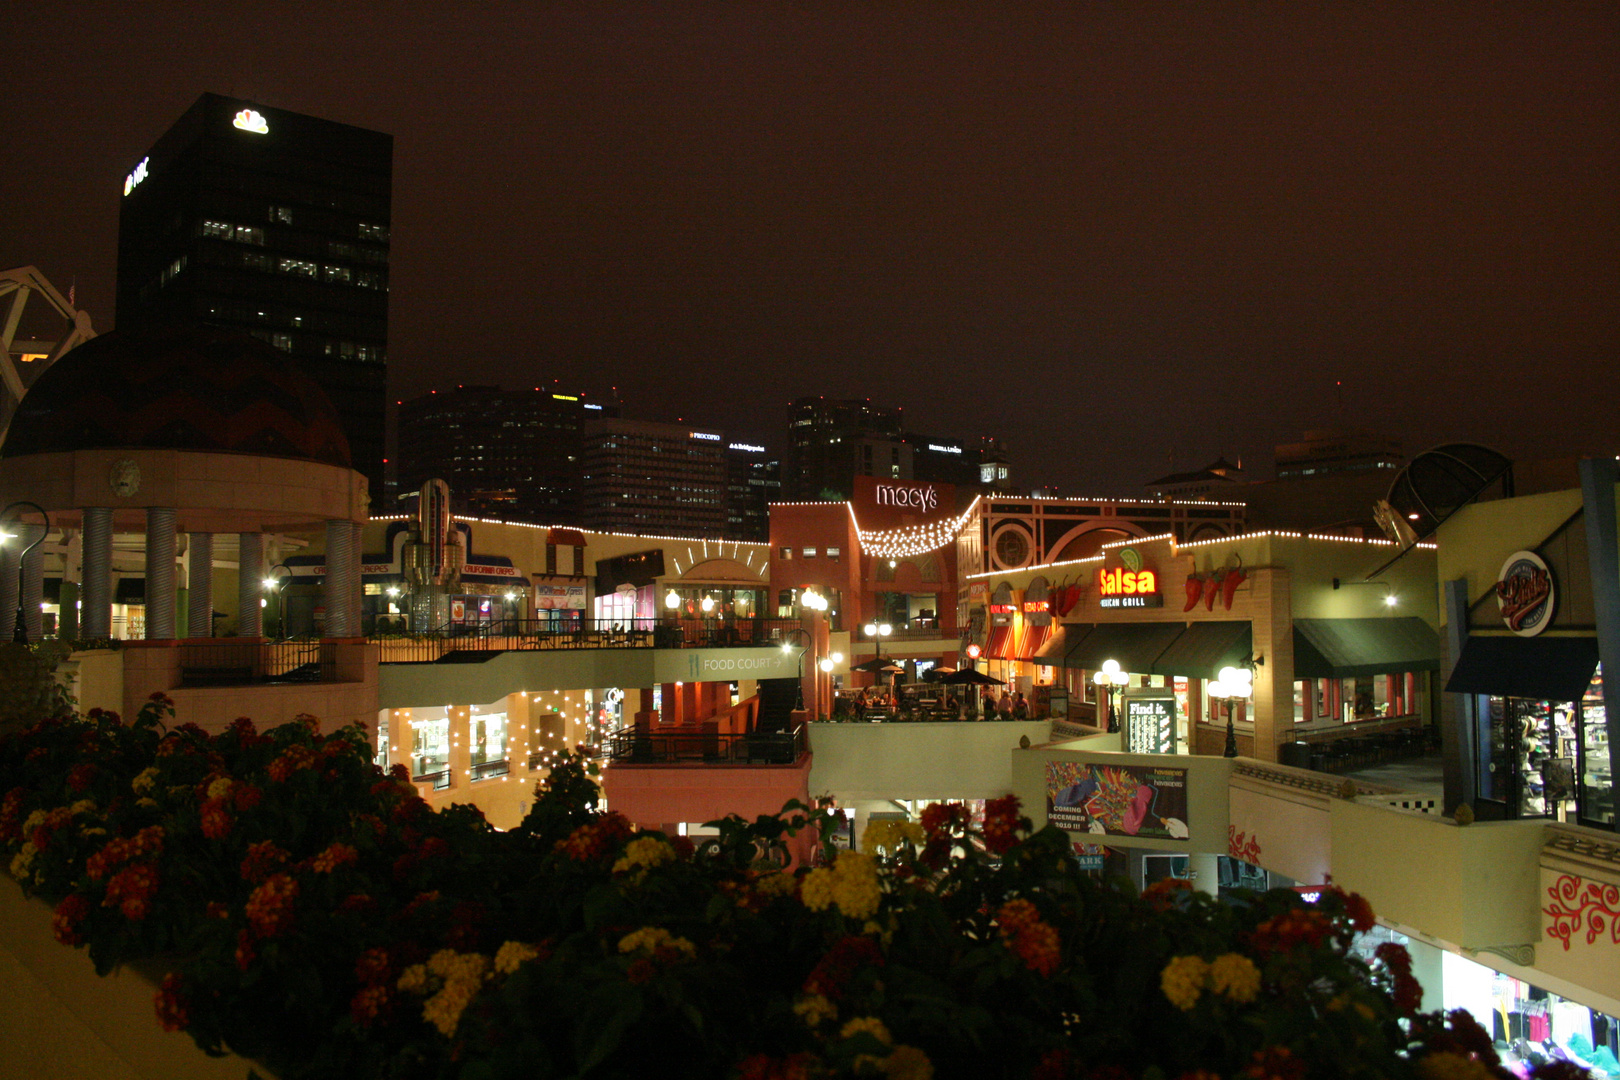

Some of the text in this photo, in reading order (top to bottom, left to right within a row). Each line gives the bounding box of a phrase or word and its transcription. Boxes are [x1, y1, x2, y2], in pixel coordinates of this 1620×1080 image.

[133, 156, 150, 188] NBC
[876, 485, 937, 513] macy's
[464, 564, 515, 576] CALIFORNIA CREPES
[1100, 567, 1156, 595] Salsa
[1122, 597, 1145, 607] GRILL
[704, 657, 772, 671] FOOD COURT
[1129, 703, 1167, 715] Find it.
[1053, 805, 1082, 814] COMING
[1048, 813, 1086, 822] DECEMBER
[1055, 821, 1081, 830] 2010 !!!
[1077, 856, 1102, 865] ARK
